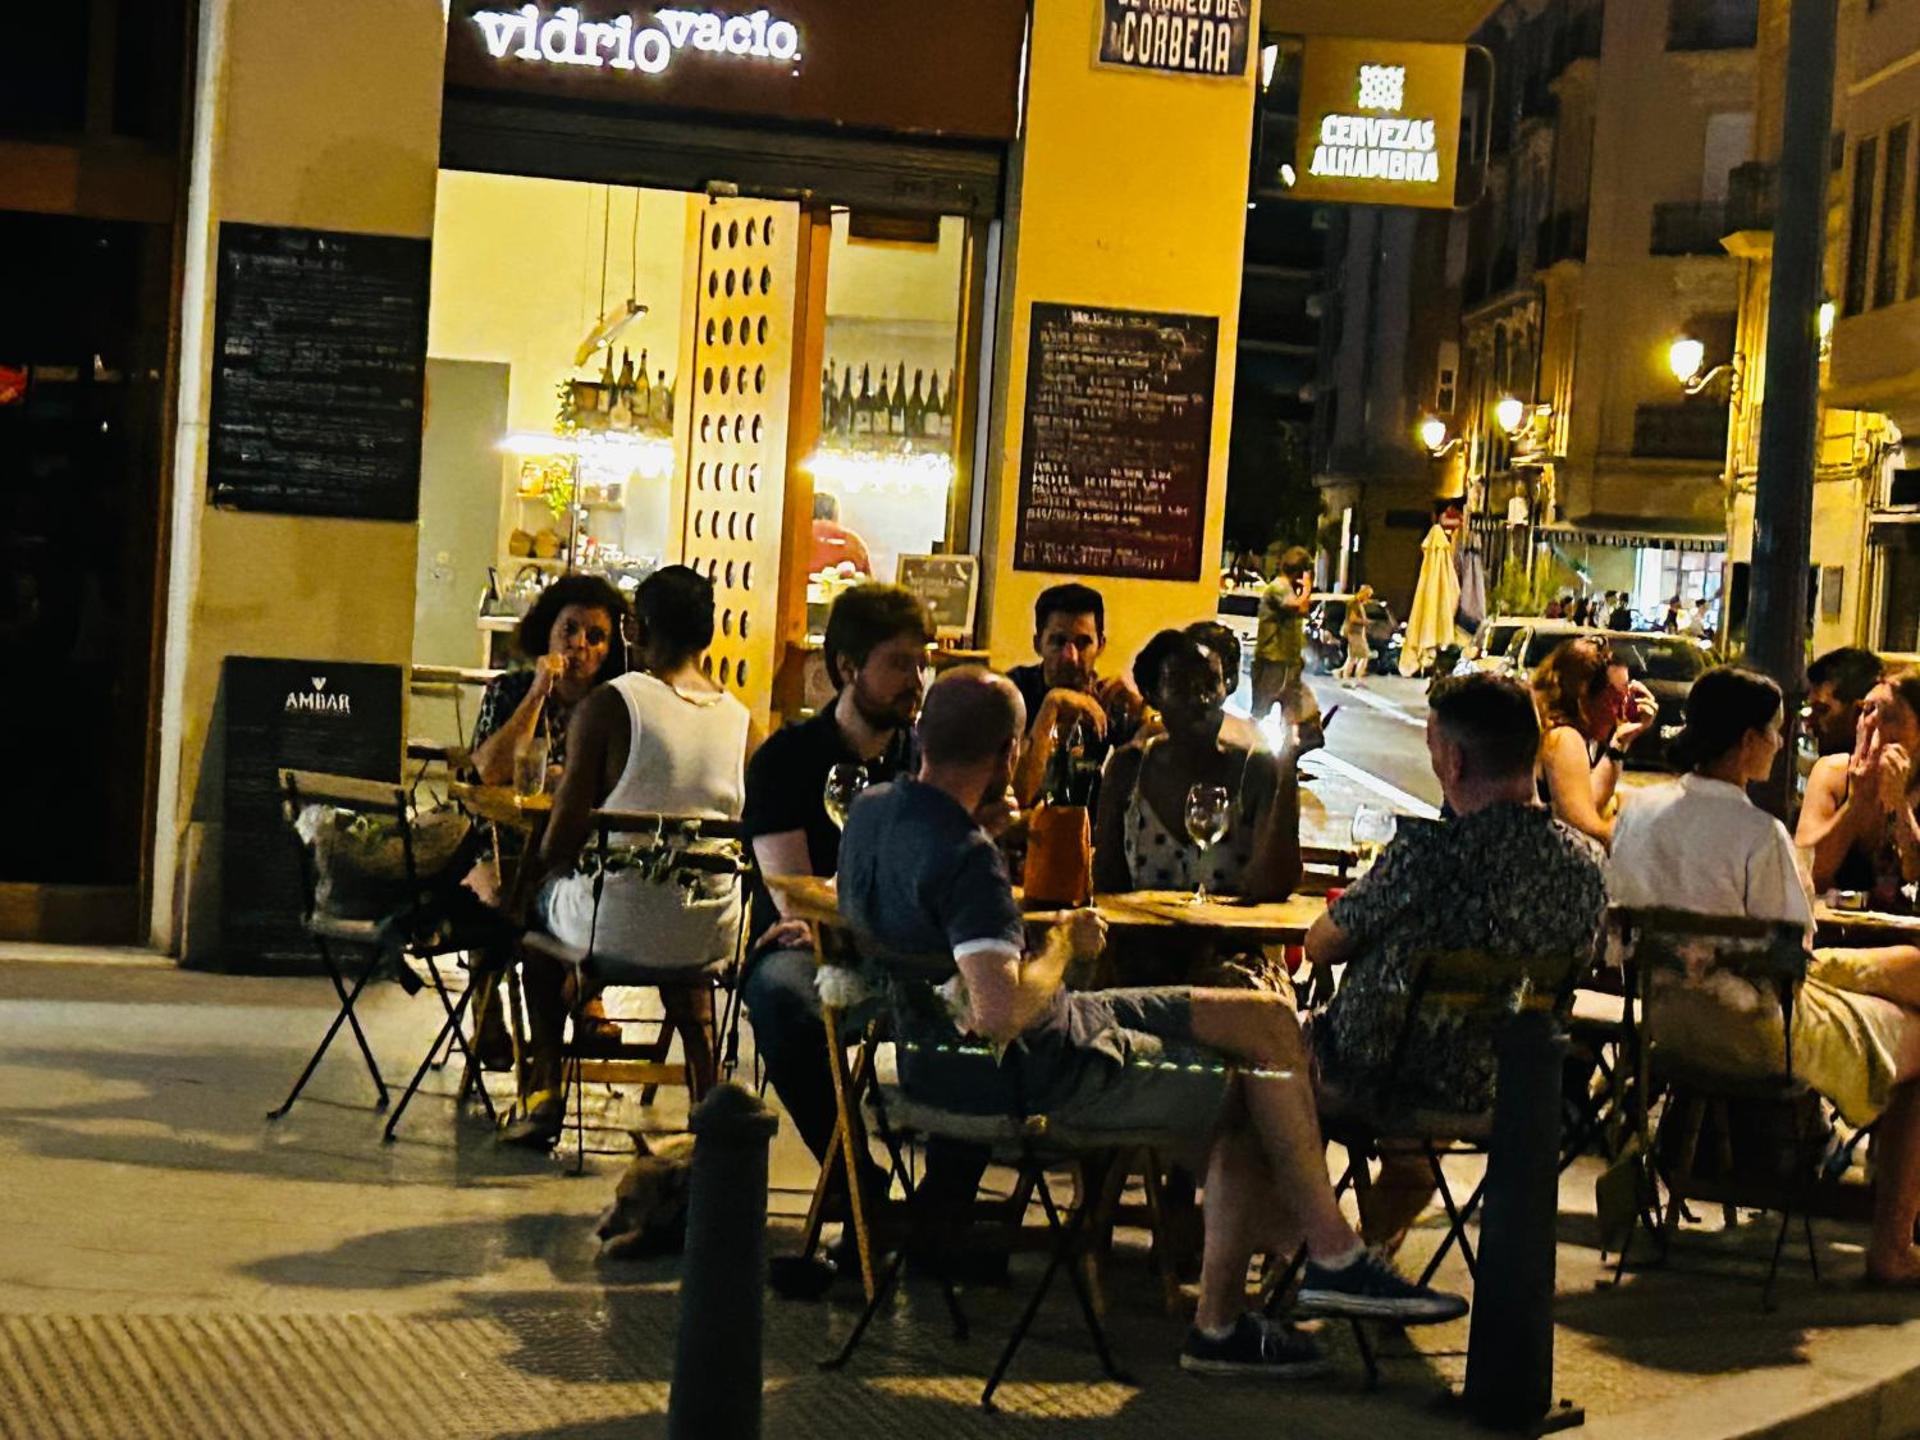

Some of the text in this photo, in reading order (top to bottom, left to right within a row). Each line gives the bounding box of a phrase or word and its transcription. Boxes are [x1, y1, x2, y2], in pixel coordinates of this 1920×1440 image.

[473, 4, 671, 73] vidrio
[1122, 11, 1231, 73] CORBERA
[1321, 114, 1435, 151] CERVEZAS
[1309, 145, 1439, 182] ALHAMBRA
